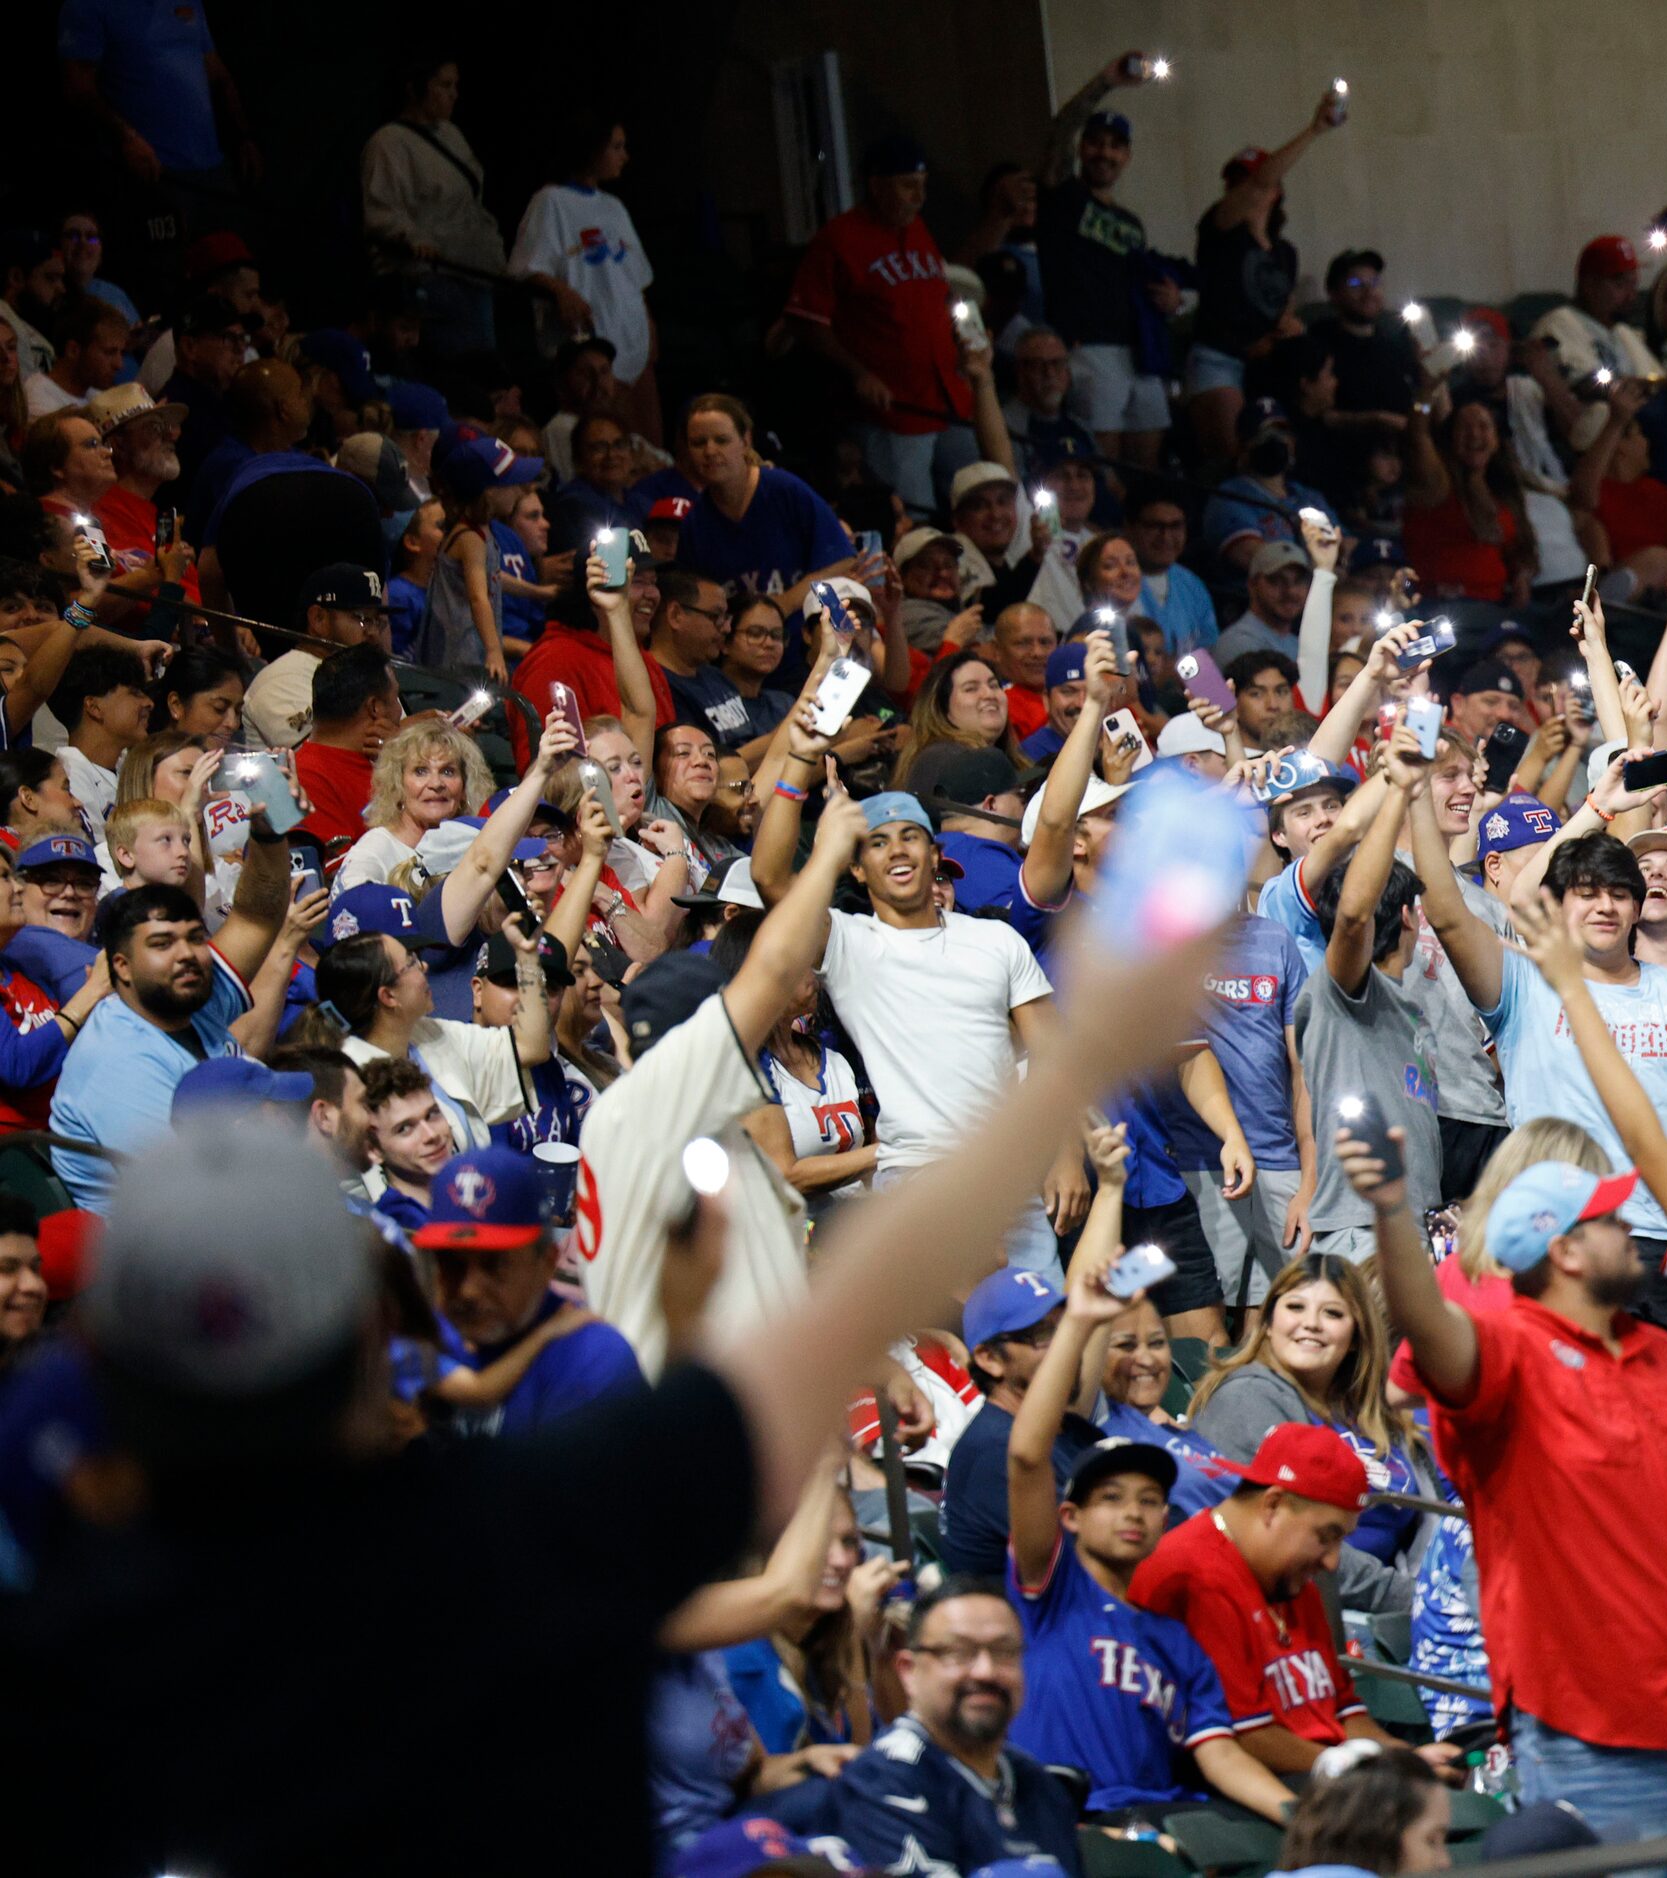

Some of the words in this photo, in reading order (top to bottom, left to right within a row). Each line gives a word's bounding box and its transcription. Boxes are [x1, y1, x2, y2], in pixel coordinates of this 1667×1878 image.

[673, 496, 692, 518] T
[502, 553, 525, 581] T
[1523, 809, 1552, 833] T
[392, 897, 413, 927] T
[811, 1100, 865, 1154] T
[1014, 1271, 1050, 1297] T
